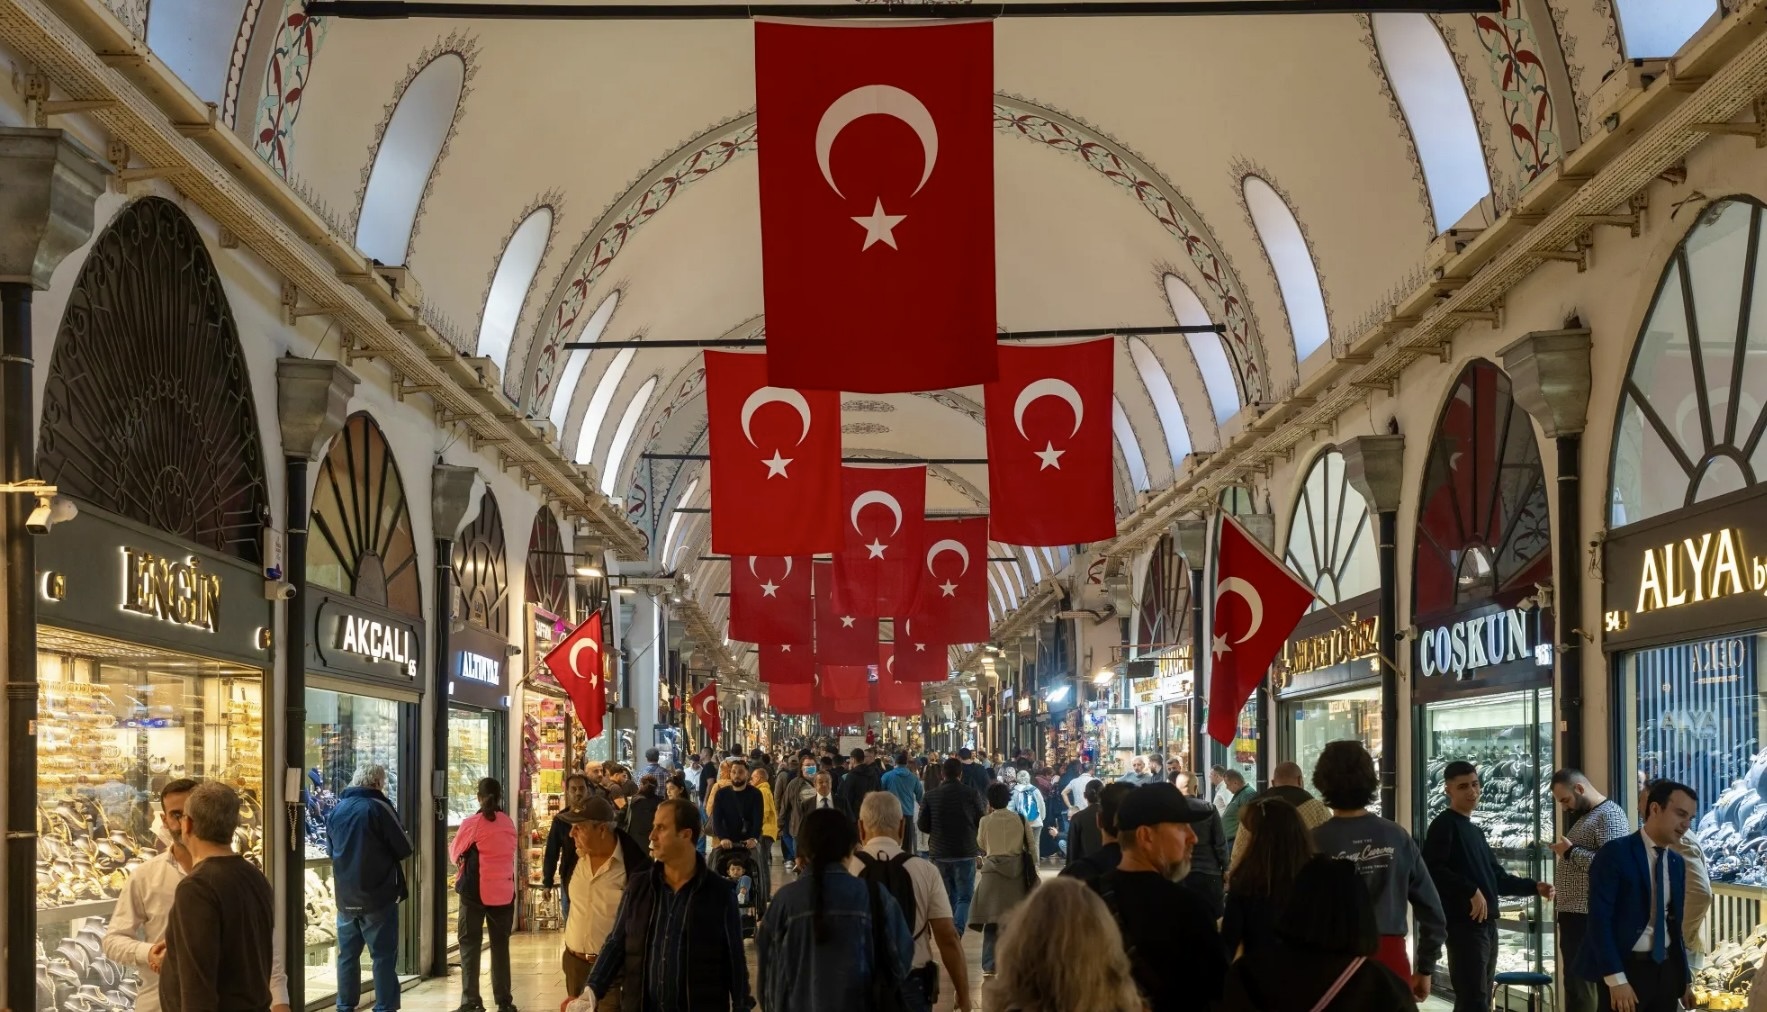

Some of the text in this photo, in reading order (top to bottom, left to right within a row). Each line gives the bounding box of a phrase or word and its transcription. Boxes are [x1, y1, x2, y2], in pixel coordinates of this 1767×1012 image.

[1636, 527, 1746, 613] ALYA
[343, 614, 409, 663] AKÇALI
[1158, 645, 1190, 678] LUXURY
[1420, 608, 1528, 681] COŞKUN
